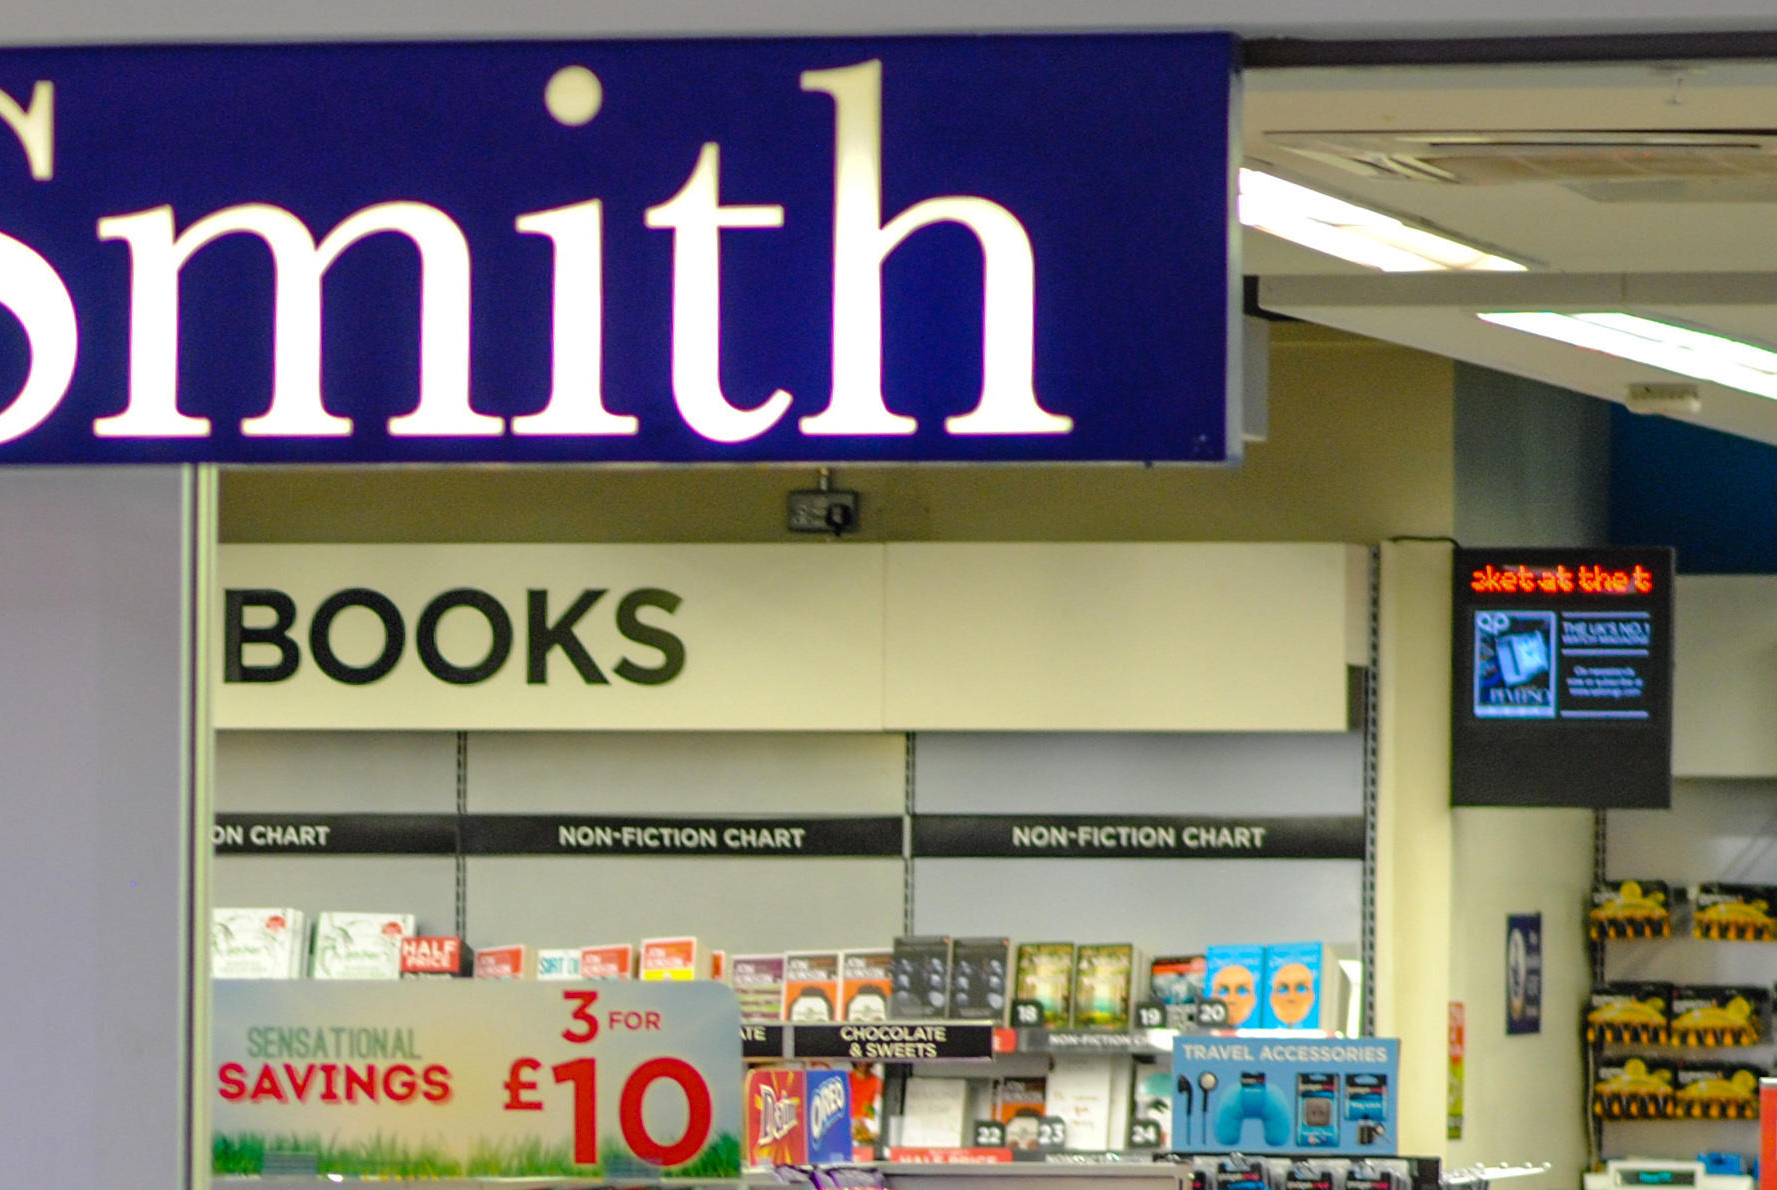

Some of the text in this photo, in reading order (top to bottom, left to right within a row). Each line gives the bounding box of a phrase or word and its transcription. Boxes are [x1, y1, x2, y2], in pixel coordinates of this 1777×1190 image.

[1538, 566, 1574, 593] at
[1578, 565, 1630, 593] the
[1633, 565, 1653, 593] t
[222, 586, 686, 686] BOOKS
[250, 825, 330, 847] CHART
[558, 825, 805, 848] NON-FICTION CHART
[1012, 825, 1266, 848] NON-FICTION CHART
[402, 938, 457, 970] HALF PRICE
[561, 989, 662, 1045] 3 FOR
[1017, 1003, 1038, 1024] 18
[1139, 1007, 1161, 1026] 19
[1199, 1001, 1226, 1023] 20
[246, 1026, 423, 1061] SENSATIONAL
[839, 1026, 947, 1042] CHOCOLATE
[849, 1042, 938, 1058] & SWEETS
[1182, 1042, 1388, 1064] TRAVEL ACCESSORIES
[217, 1056, 714, 1167] SAVINGS £10
[978, 1125, 1002, 1144] 22
[1038, 1124, 1065, 1143] 23
[1132, 1125, 1156, 1143] 24
